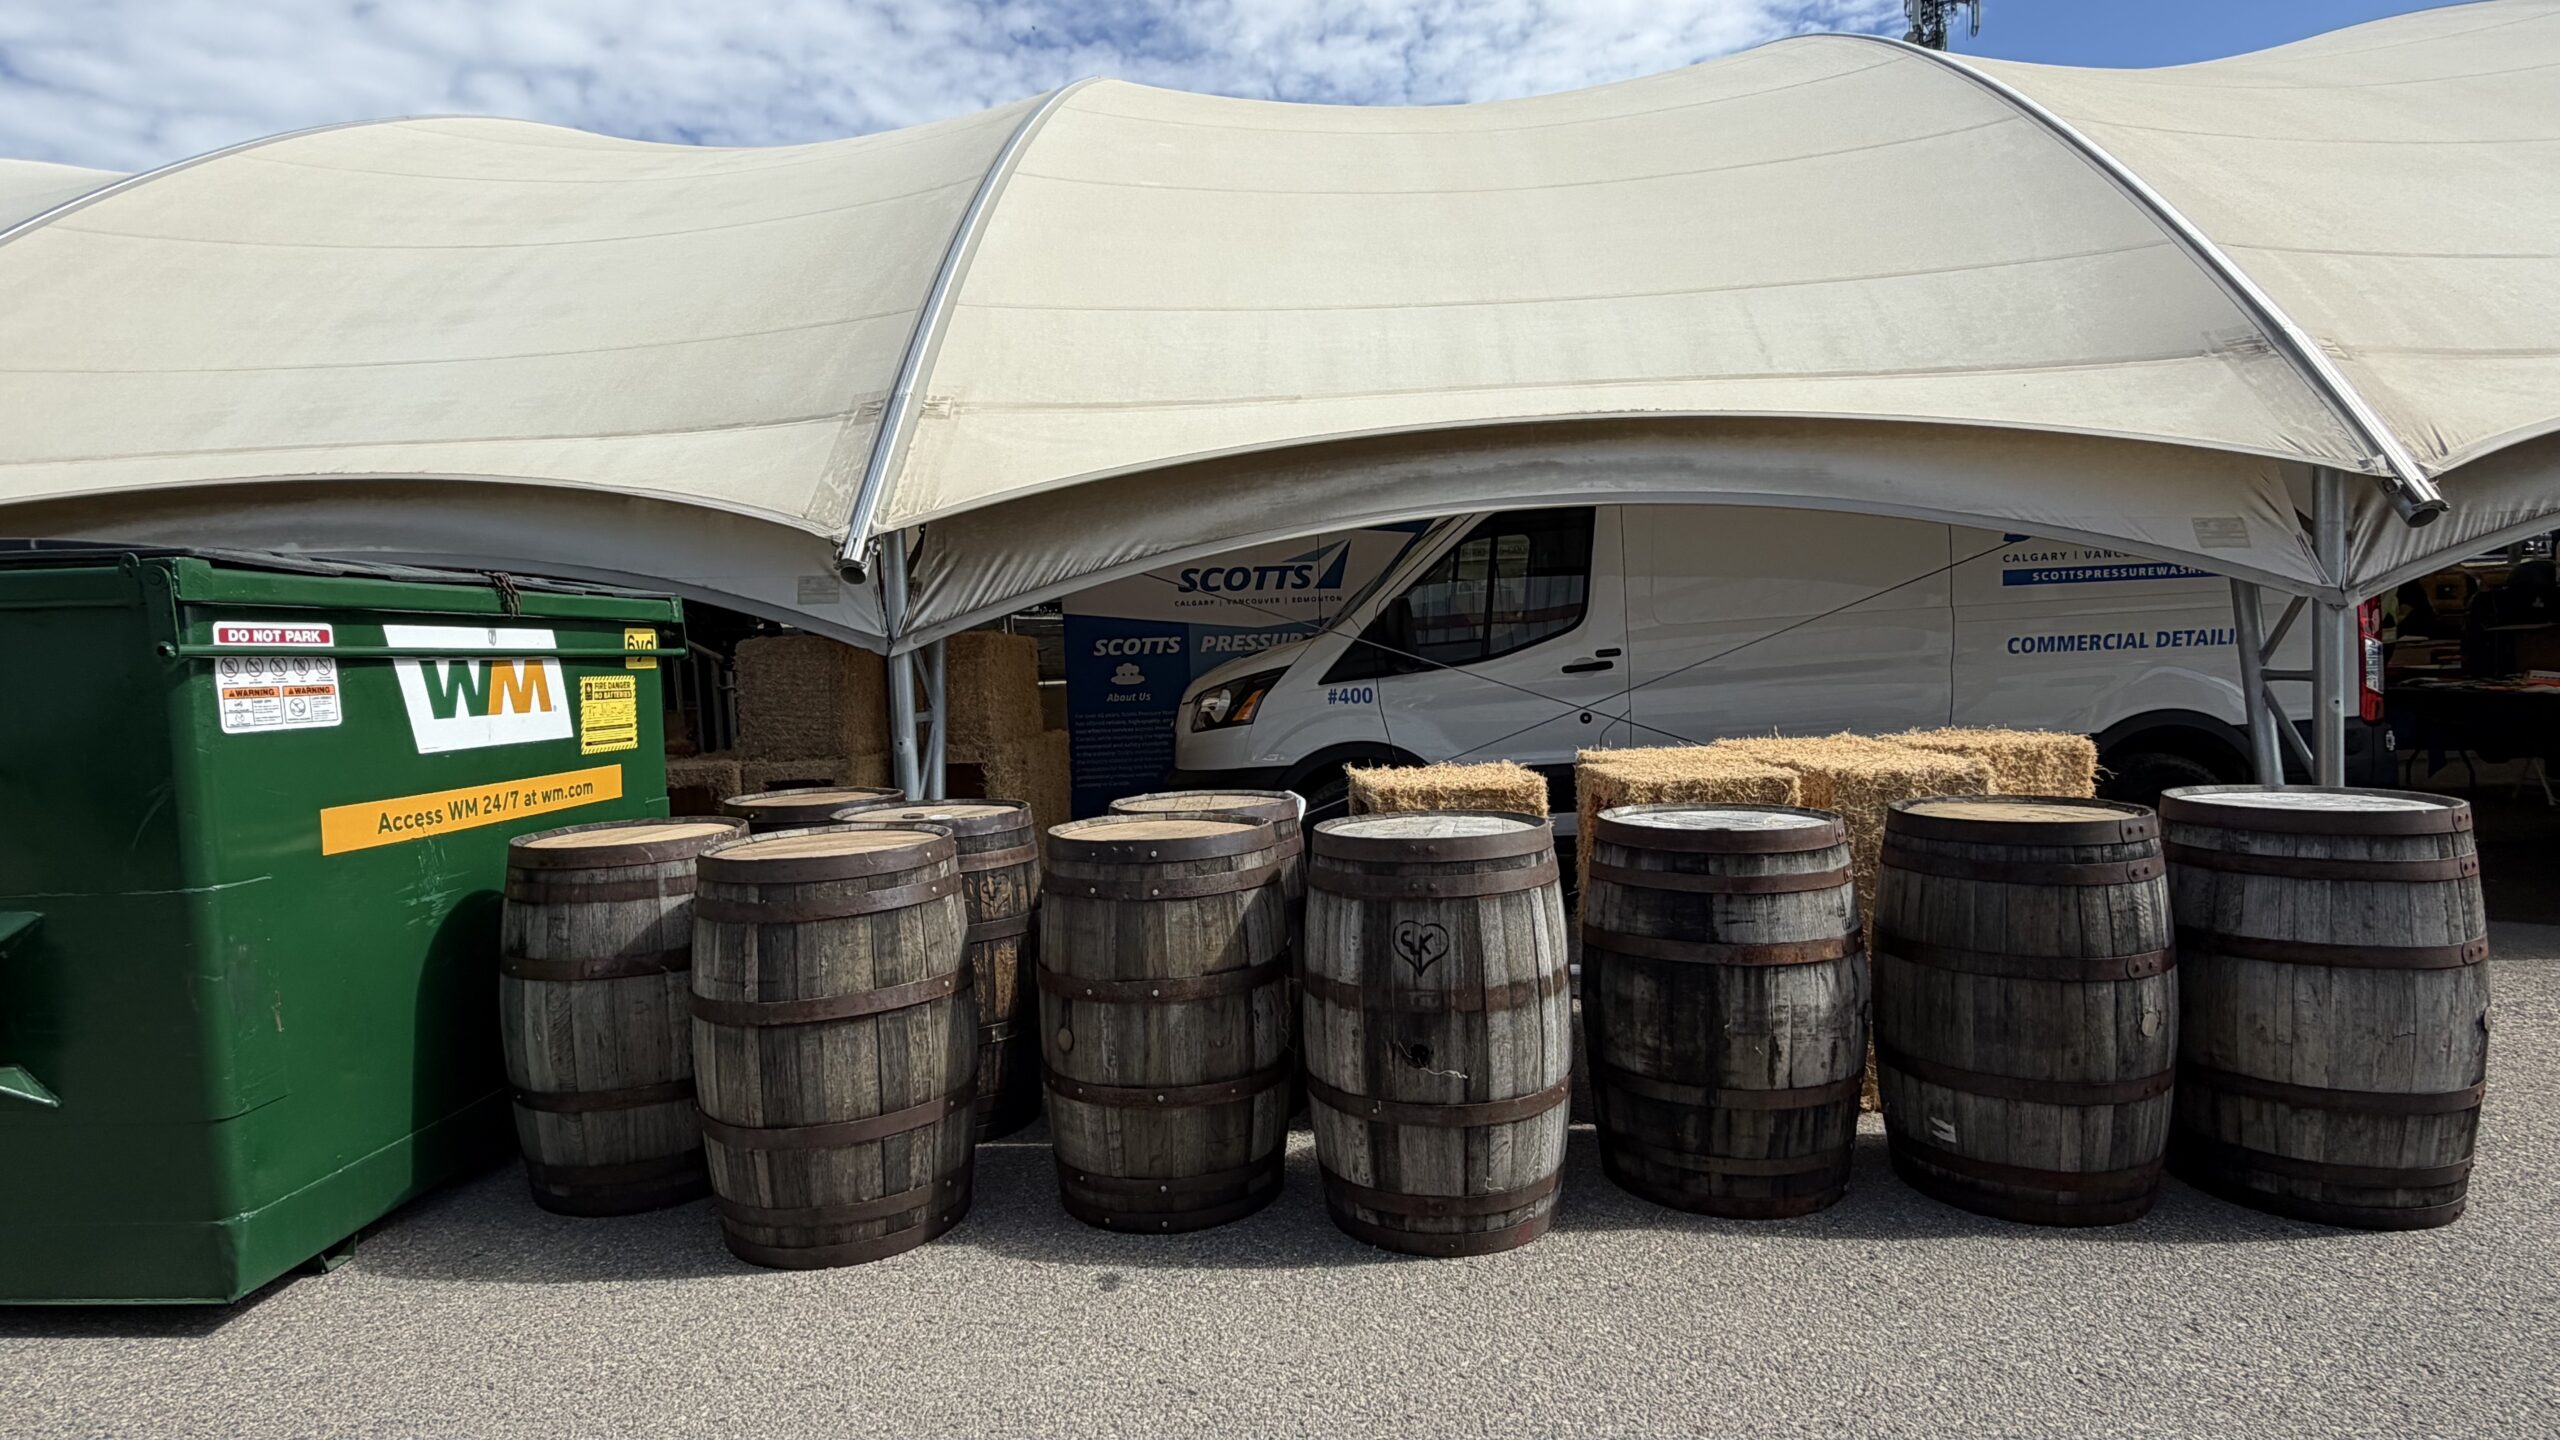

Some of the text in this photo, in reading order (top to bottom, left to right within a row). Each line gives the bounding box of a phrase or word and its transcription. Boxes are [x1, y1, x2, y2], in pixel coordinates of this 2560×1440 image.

[2003, 551, 2067, 563] CALGARY
[1178, 564, 1314, 593] SCOTTS
[2032, 565, 2208, 582] SCOTTSPRESSUREWASH.
[1227, 597, 1281, 605] VANCOUVER
[1292, 595, 1343, 603] EDMONTON
[228, 629, 321, 642] DO NOT PARK
[2007, 628, 2236, 654] COMMERCIAL DETAILI
[1093, 636, 1182, 657] SCOTTS
[235, 688, 275, 698] WARNING
[294, 686, 331, 695] WARNING
[418, 660, 552, 720] WM
[594, 681, 631, 690] FIRE DANGER
[1106, 692, 1152, 702] About Us
[1328, 687, 1373, 705] #400
[378, 780, 594, 834] Access WM 24/7 at wm.com
